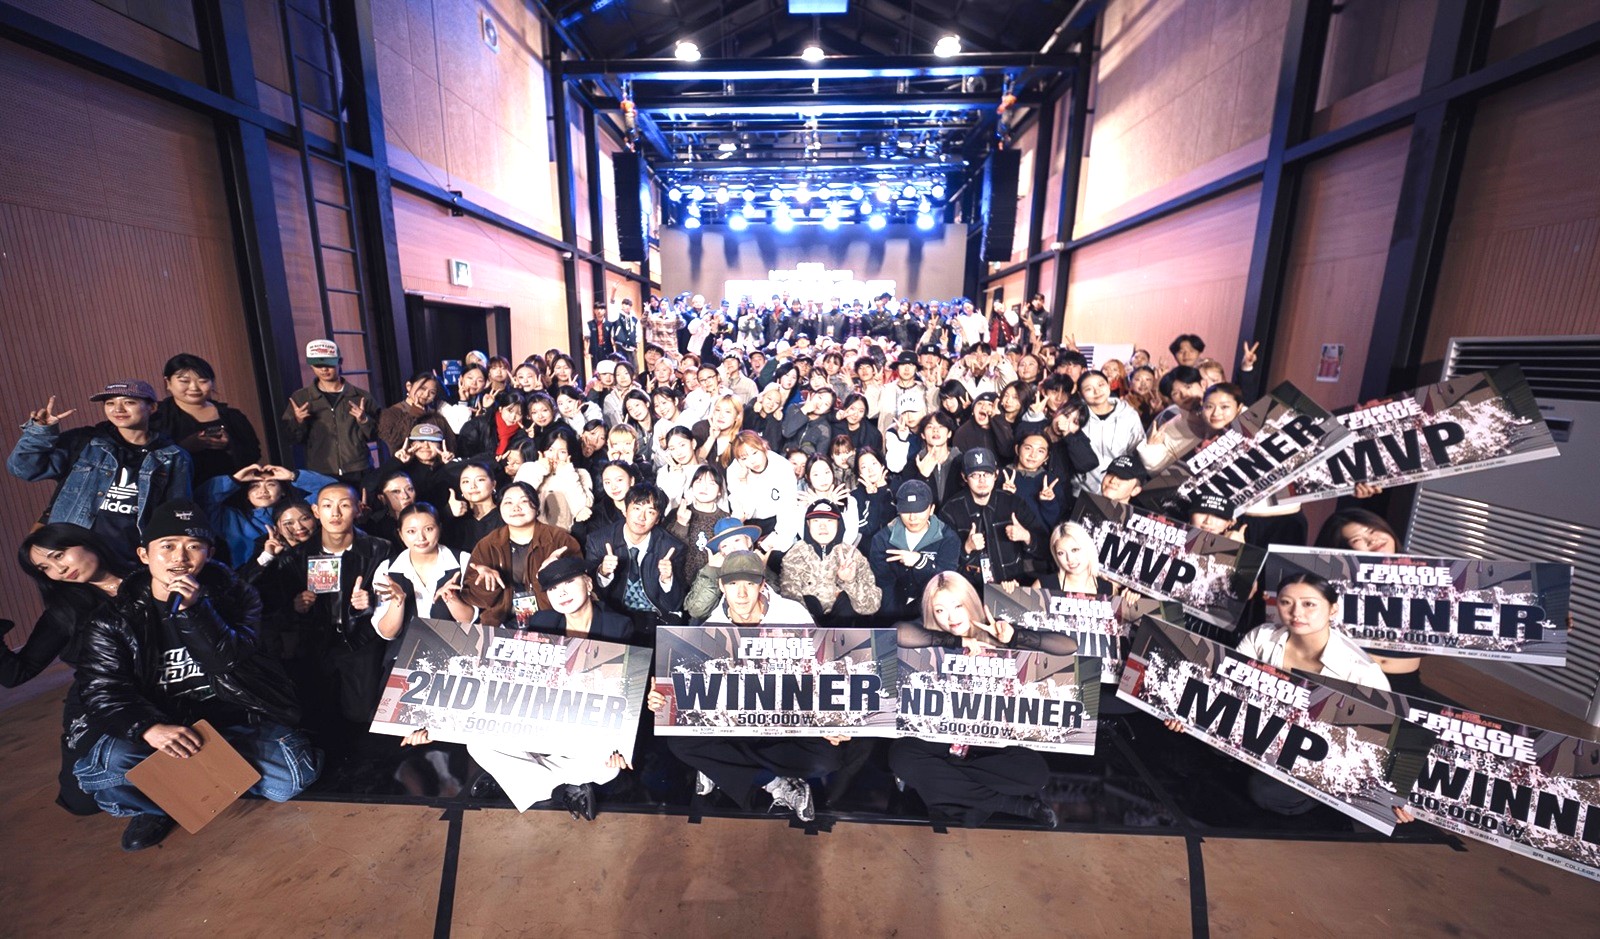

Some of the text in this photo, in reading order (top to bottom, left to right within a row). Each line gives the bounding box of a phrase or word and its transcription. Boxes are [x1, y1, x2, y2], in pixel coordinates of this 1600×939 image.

[1348, 404, 1423, 430] EAGUE
[1326, 421, 1465, 485] MVP
[1099, 532, 1196, 593] MVP
[1343, 594, 1546, 641] INNER
[400, 670, 628, 729] 2ND WINNER
[672, 673, 881, 711] WINNER
[901, 687, 1084, 728] ND WINNER
[1176, 676, 1329, 772] MVP
[1408, 707, 1535, 752] FRINGE
[1410, 719, 1537, 765] EAGUE
